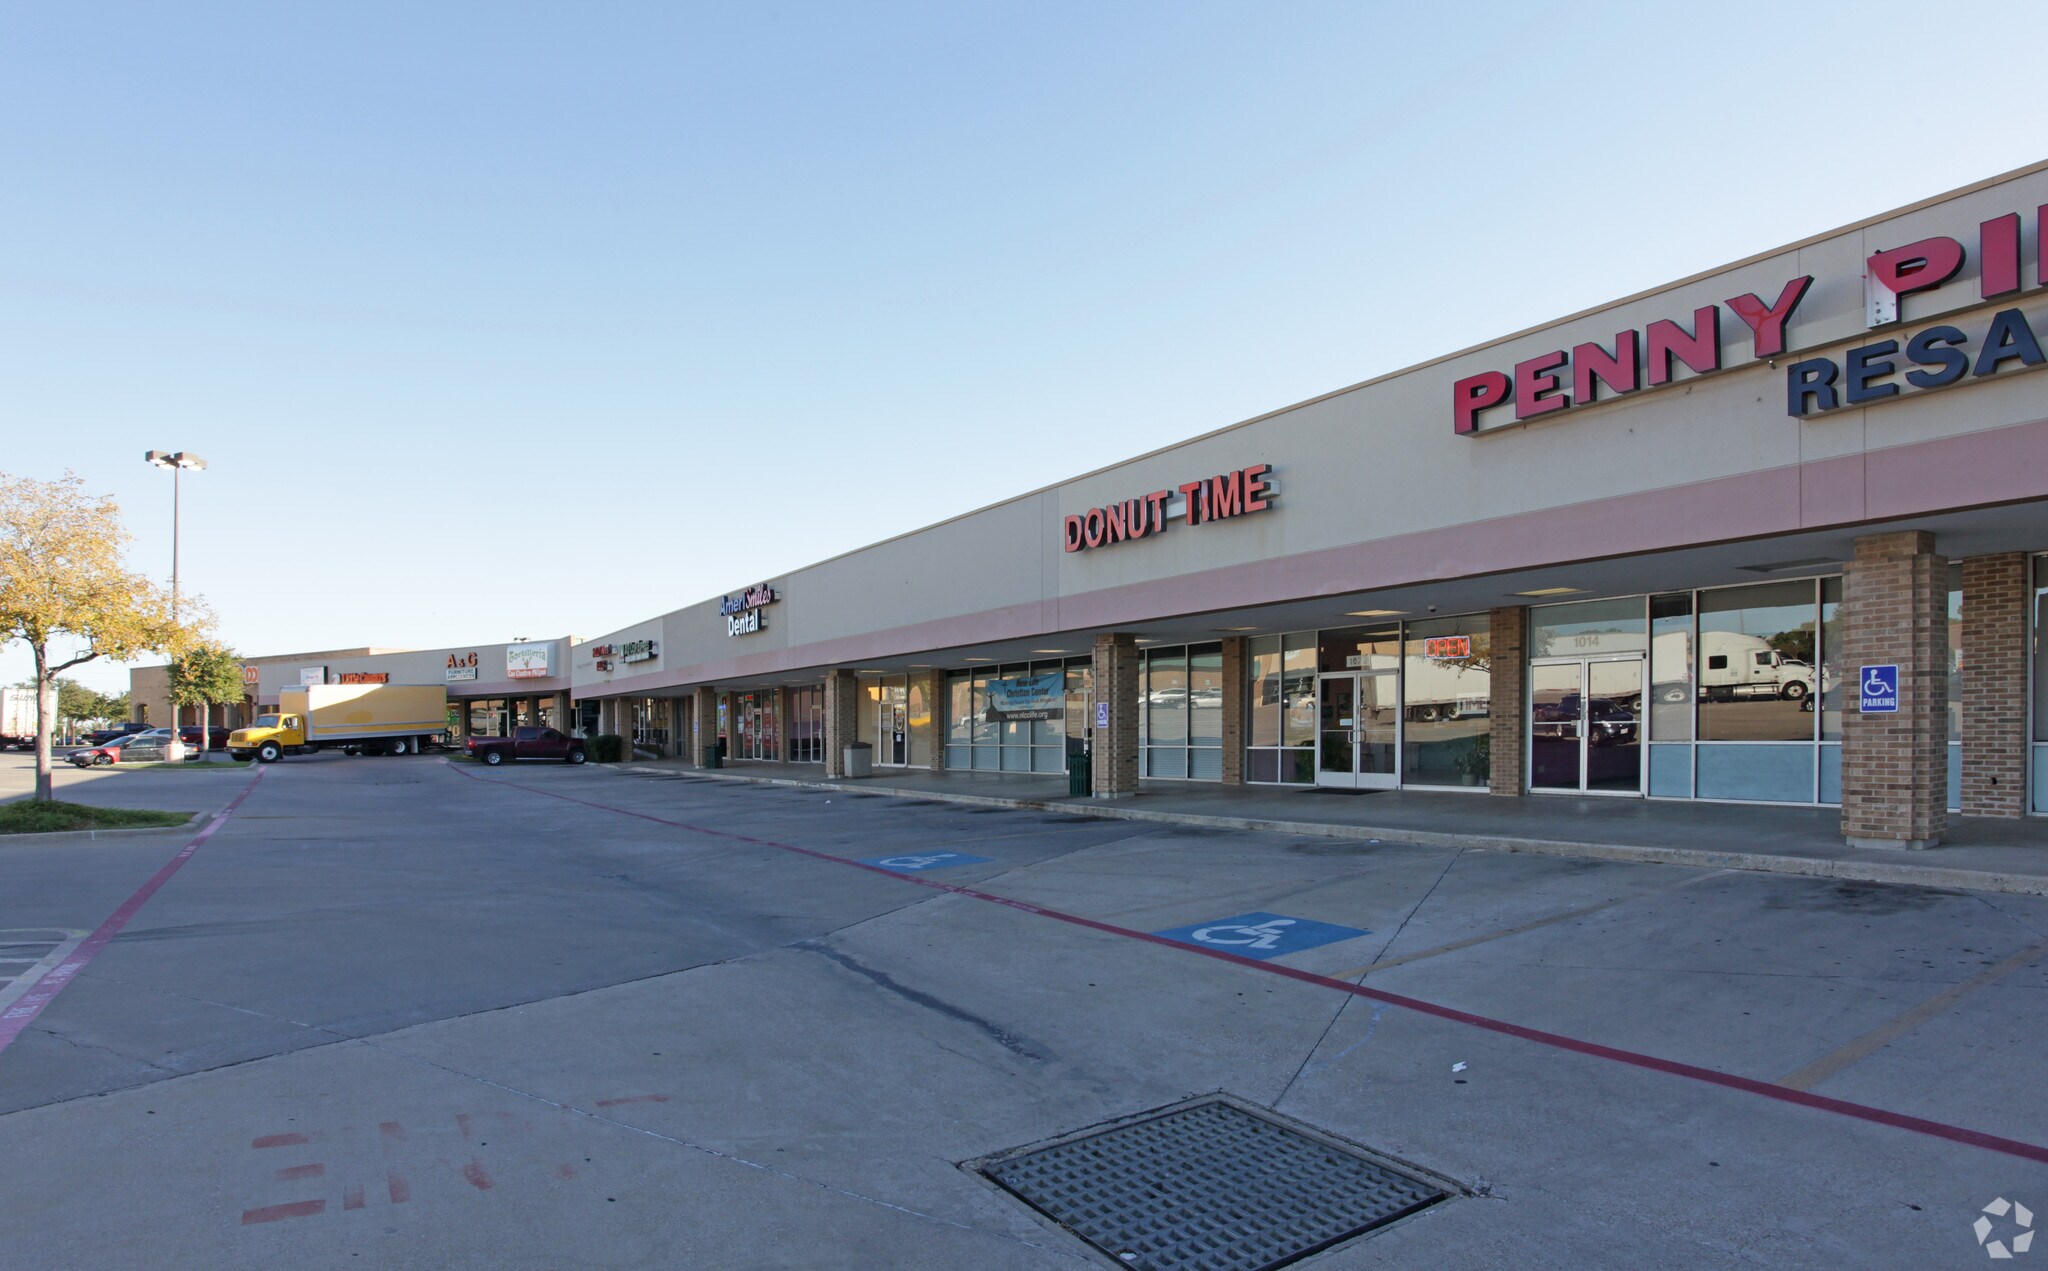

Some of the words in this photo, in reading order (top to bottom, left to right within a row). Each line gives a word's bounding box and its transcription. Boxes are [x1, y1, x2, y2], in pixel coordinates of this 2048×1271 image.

[1454, 275, 1812, 437] PENNY
[1787, 307, 2047, 418] RESA
[1065, 490, 1170, 553] DONUT
[1179, 464, 1269, 526] TIME
[728, 608, 760, 637] Dental
[1426, 638, 1470, 657] OPEN
[1573, 635, 1600, 648] 1014
[508, 648, 546, 663] Tortilleria
[1016, 679, 1028, 687] New
[1029, 677, 1040, 686] Life
[1006, 688, 1031, 698] Christian
[1031, 687, 1050, 696] Center
[1862, 697, 1895, 708] PARKING
